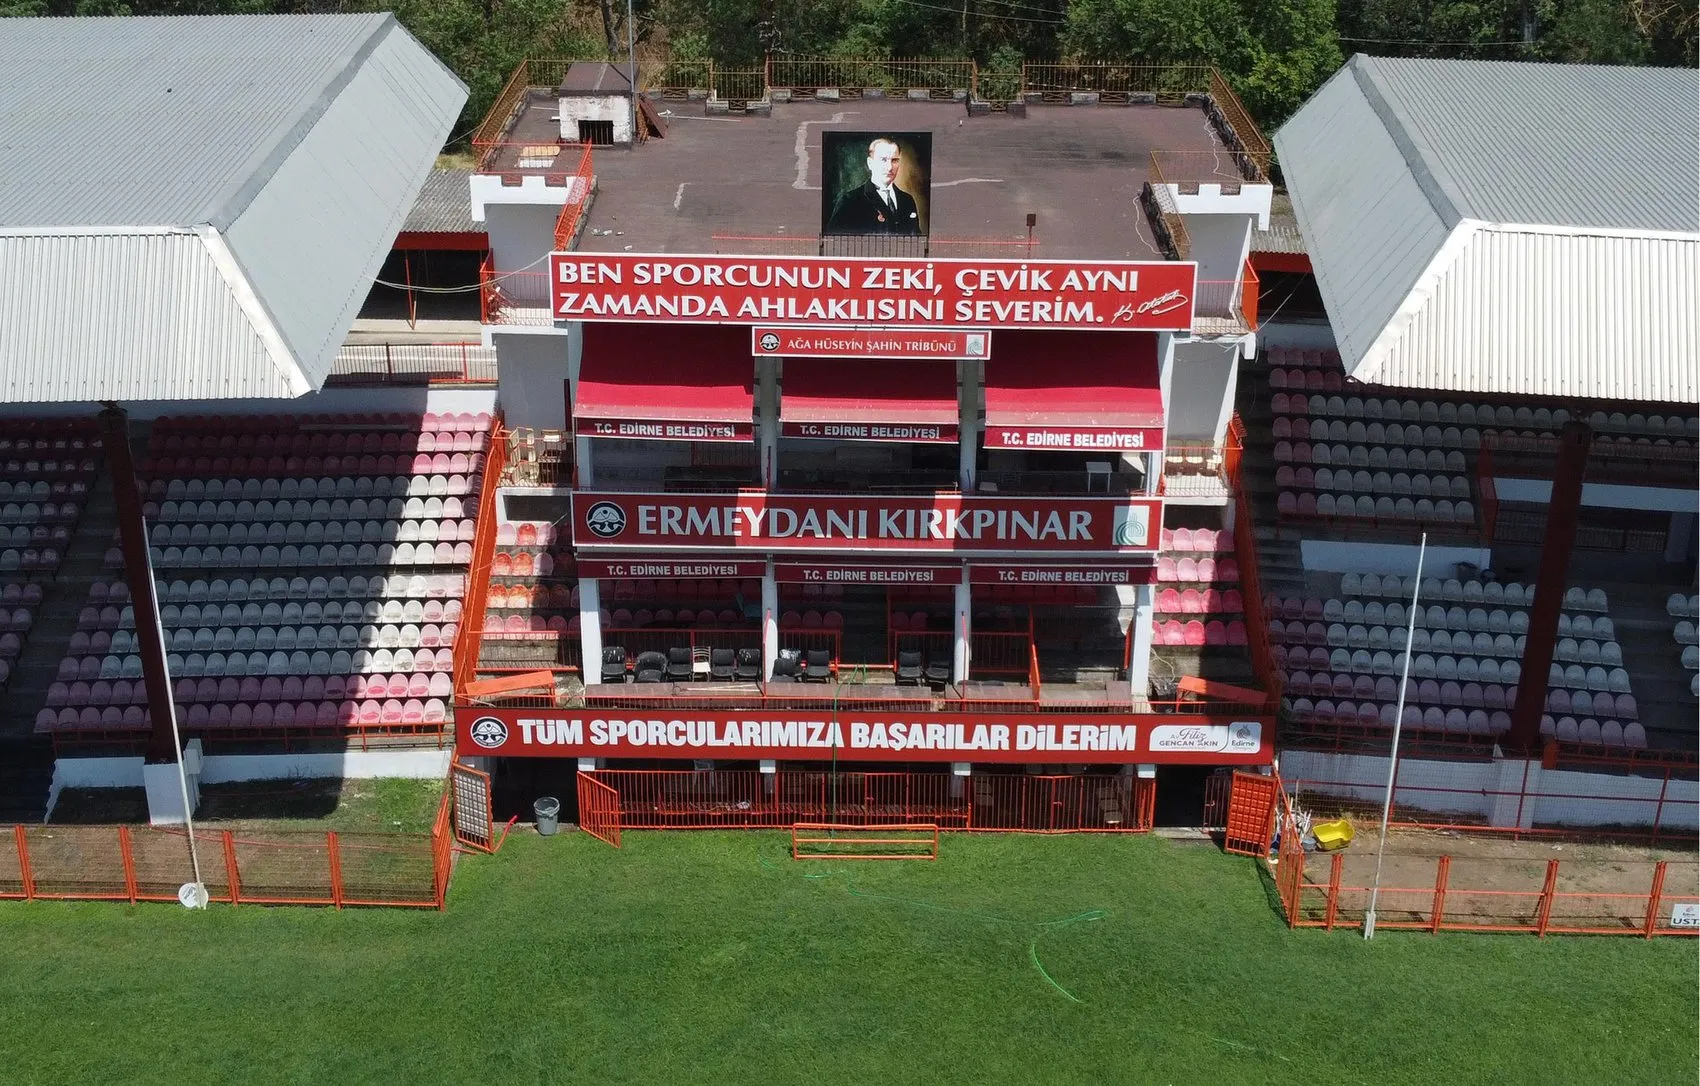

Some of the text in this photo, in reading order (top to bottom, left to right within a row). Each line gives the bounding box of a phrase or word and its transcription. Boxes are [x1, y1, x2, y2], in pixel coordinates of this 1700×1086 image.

[558, 262, 1139, 297] BEN SPORCUNUN ZEKİ, ÇEVİK AYNI
[559, 293, 1104, 323] ZAMANDA AHLAKLISINI SEVERİM.
[787, 337, 956, 352] AĞA HÜSEYİN ŞAHİN TRİBÜNÜ
[595, 422, 735, 437] T.C. EDİRNE BELEDİYESİ
[800, 424, 940, 439] T.C. EDİRNE BELEDİYESİ
[1002, 430, 1144, 447] T.C. EDİRNE BELEDİYESİ
[637, 505, 1094, 541] ERMEYDANI KIRKPINAR
[607, 563, 738, 576] T.C. EDİRNE BELEDİYESİ
[803, 569, 934, 581] T.C. EDİRNE BELEDİYESİ
[998, 569, 1129, 582] T.C. EDİRNE BELEDİYESİ
[516, 718, 584, 746] TÜM
[589, 719, 844, 748] SPORCULARIMIZA
[851, 722, 1010, 751] BAŞARILAR
[1179, 727, 1207, 742] Filiz
